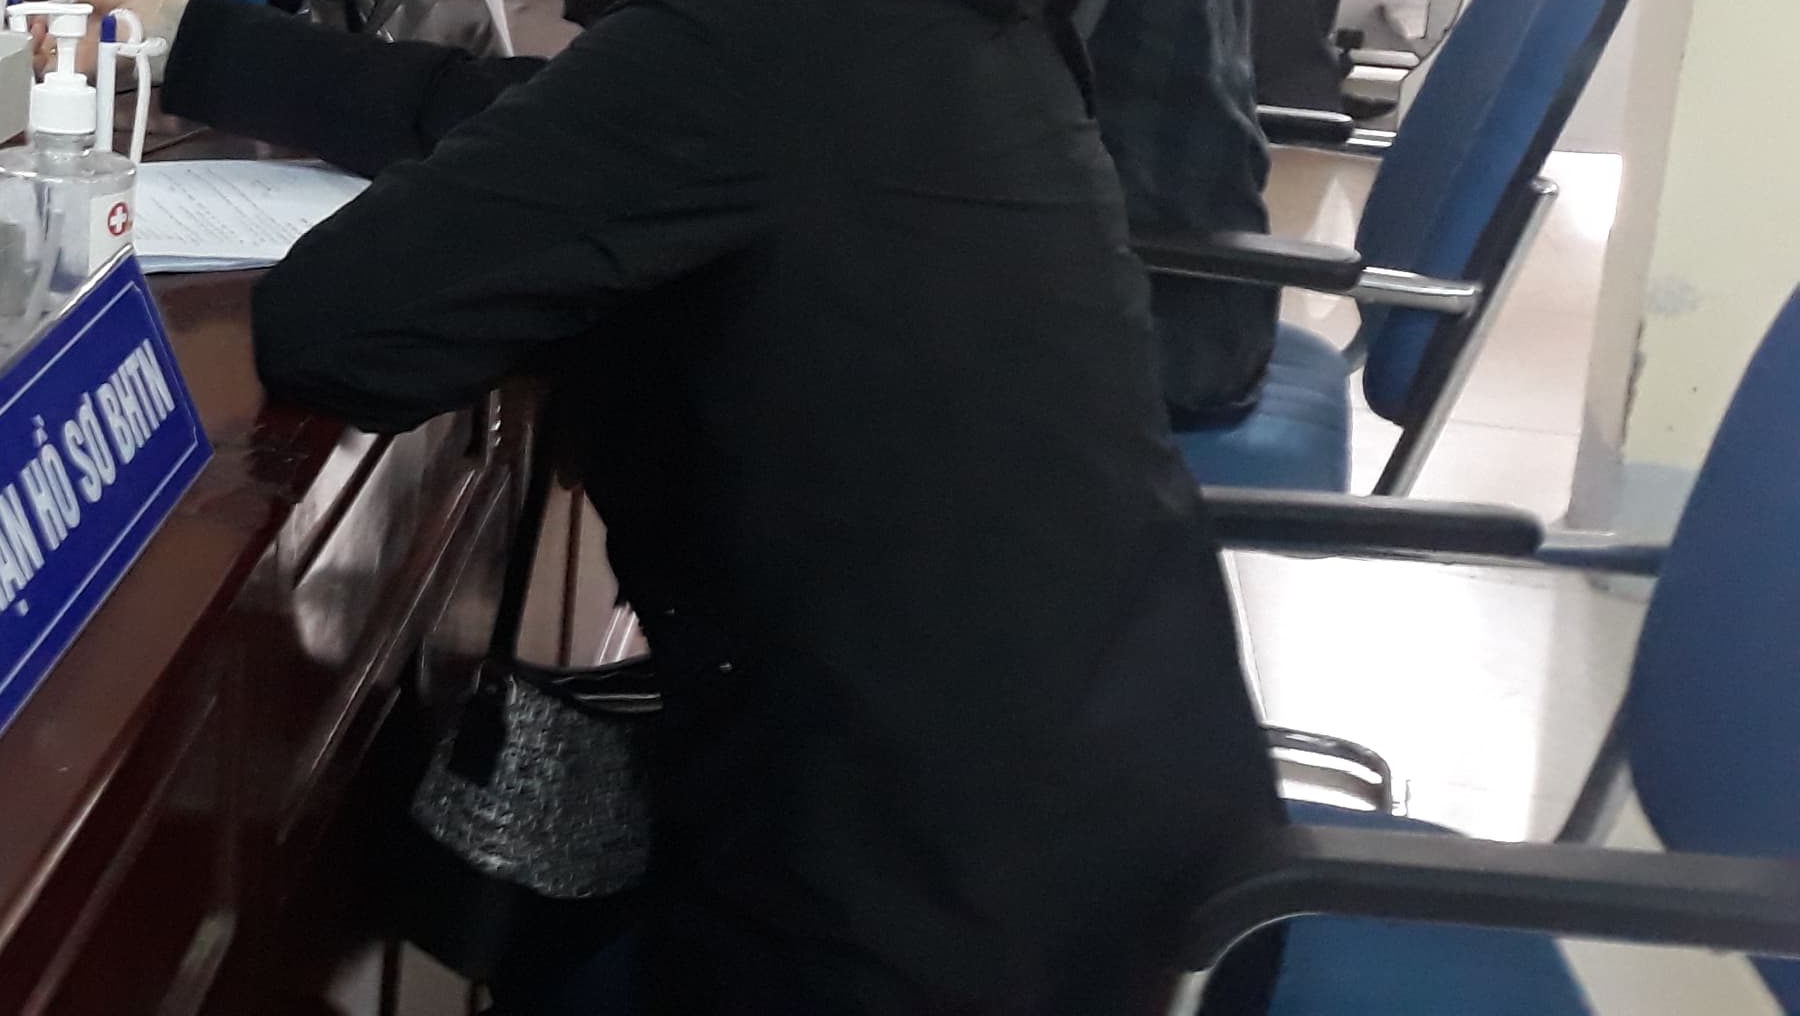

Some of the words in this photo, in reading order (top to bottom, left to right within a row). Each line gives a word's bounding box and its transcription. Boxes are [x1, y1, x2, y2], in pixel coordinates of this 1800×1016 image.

[20, 414, 81, 551] HỒ
[64, 391, 116, 504] SƠ
[96, 337, 176, 465] BHTN
